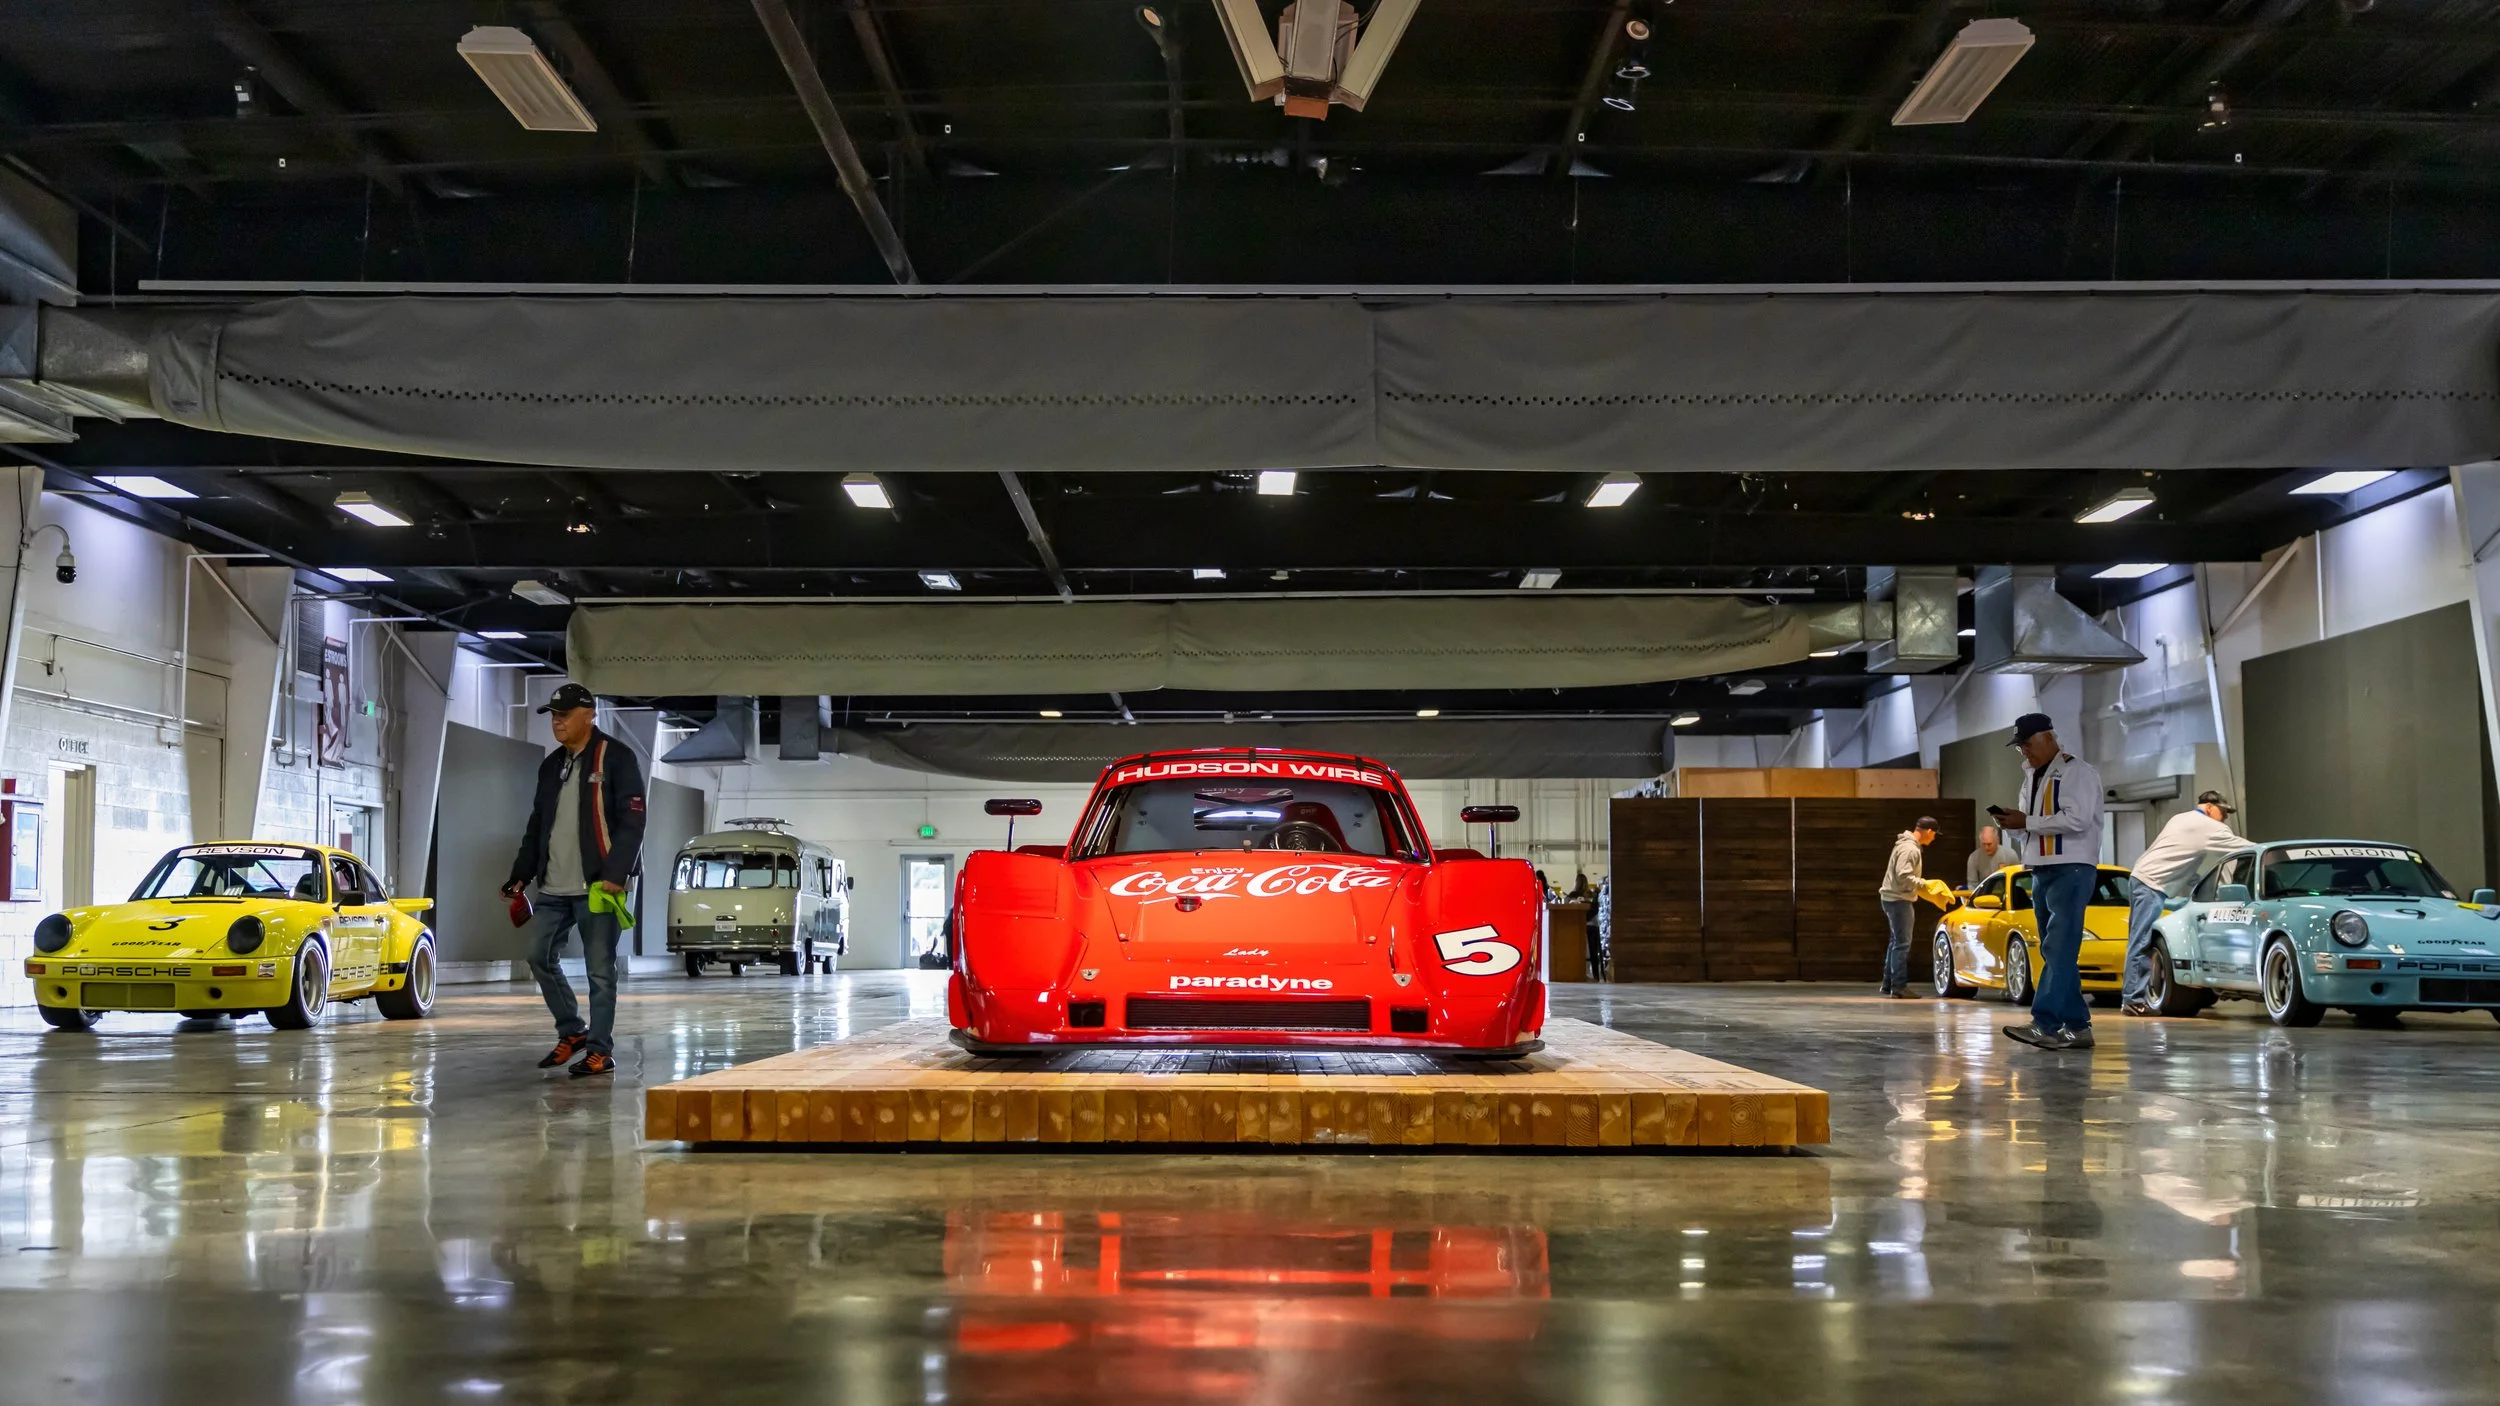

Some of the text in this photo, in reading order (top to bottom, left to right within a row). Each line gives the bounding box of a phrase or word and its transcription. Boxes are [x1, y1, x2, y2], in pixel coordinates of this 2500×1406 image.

[1117, 762, 1384, 786] HUDSON WIRE
[196, 846, 285, 855] REVSON
[2304, 848, 2396, 858] ALLISON
[1190, 866, 1245, 876] Enjoy
[1109, 864, 1392, 905] Coca-Cola
[2213, 908, 2250, 922] ALLISON
[148, 917, 187, 931] 3
[1222, 948, 1270, 957] Lady
[1432, 924, 1523, 976] 5
[62, 966, 192, 977] PORSCHE
[333, 962, 389, 980] PORSCHE
[1169, 974, 1334, 992] paradyne
